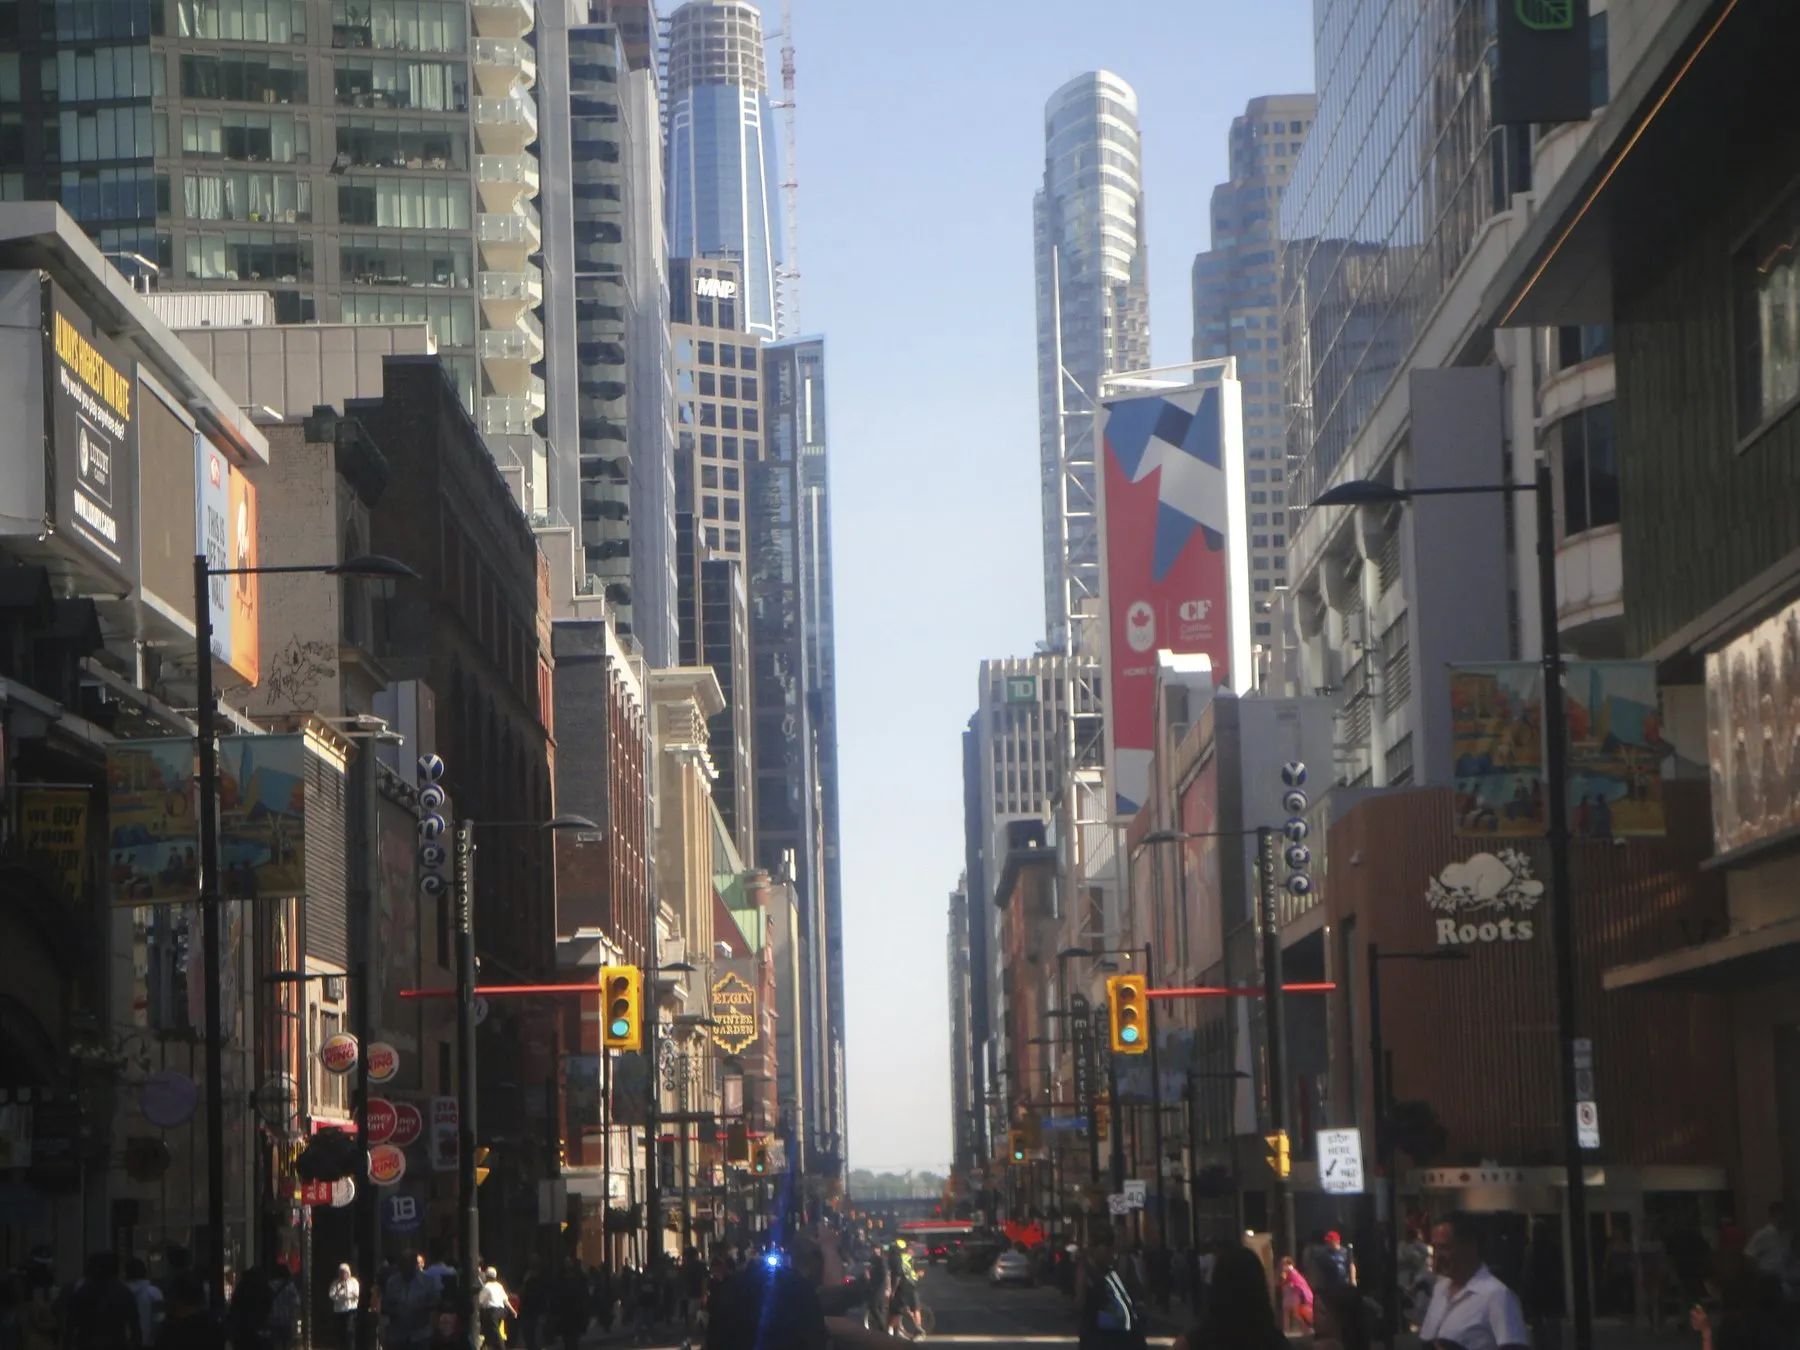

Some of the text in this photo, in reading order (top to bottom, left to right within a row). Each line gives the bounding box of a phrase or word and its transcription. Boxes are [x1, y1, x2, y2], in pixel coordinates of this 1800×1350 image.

[56, 311, 79, 373] ALWAYS
[79, 334, 103, 396] HIGHEST
[115, 371, 130, 421] RATE
[208, 504, 224, 547] THIS IS
[53, 806, 82, 826] BUY
[457, 829, 468, 934] DOWNTOWN
[1436, 917, 1533, 945] Roots
[713, 991, 752, 1004] ELGIN
[713, 1014, 753, 1025] WINTER
[713, 1024, 754, 1035] GARDEN
[326, 1048, 355, 1065] KING
[367, 1114, 392, 1122] oney
[367, 1123, 384, 1132] art
[1328, 1147, 1350, 1155] HERE
[1345, 1158, 1358, 1166] ON
